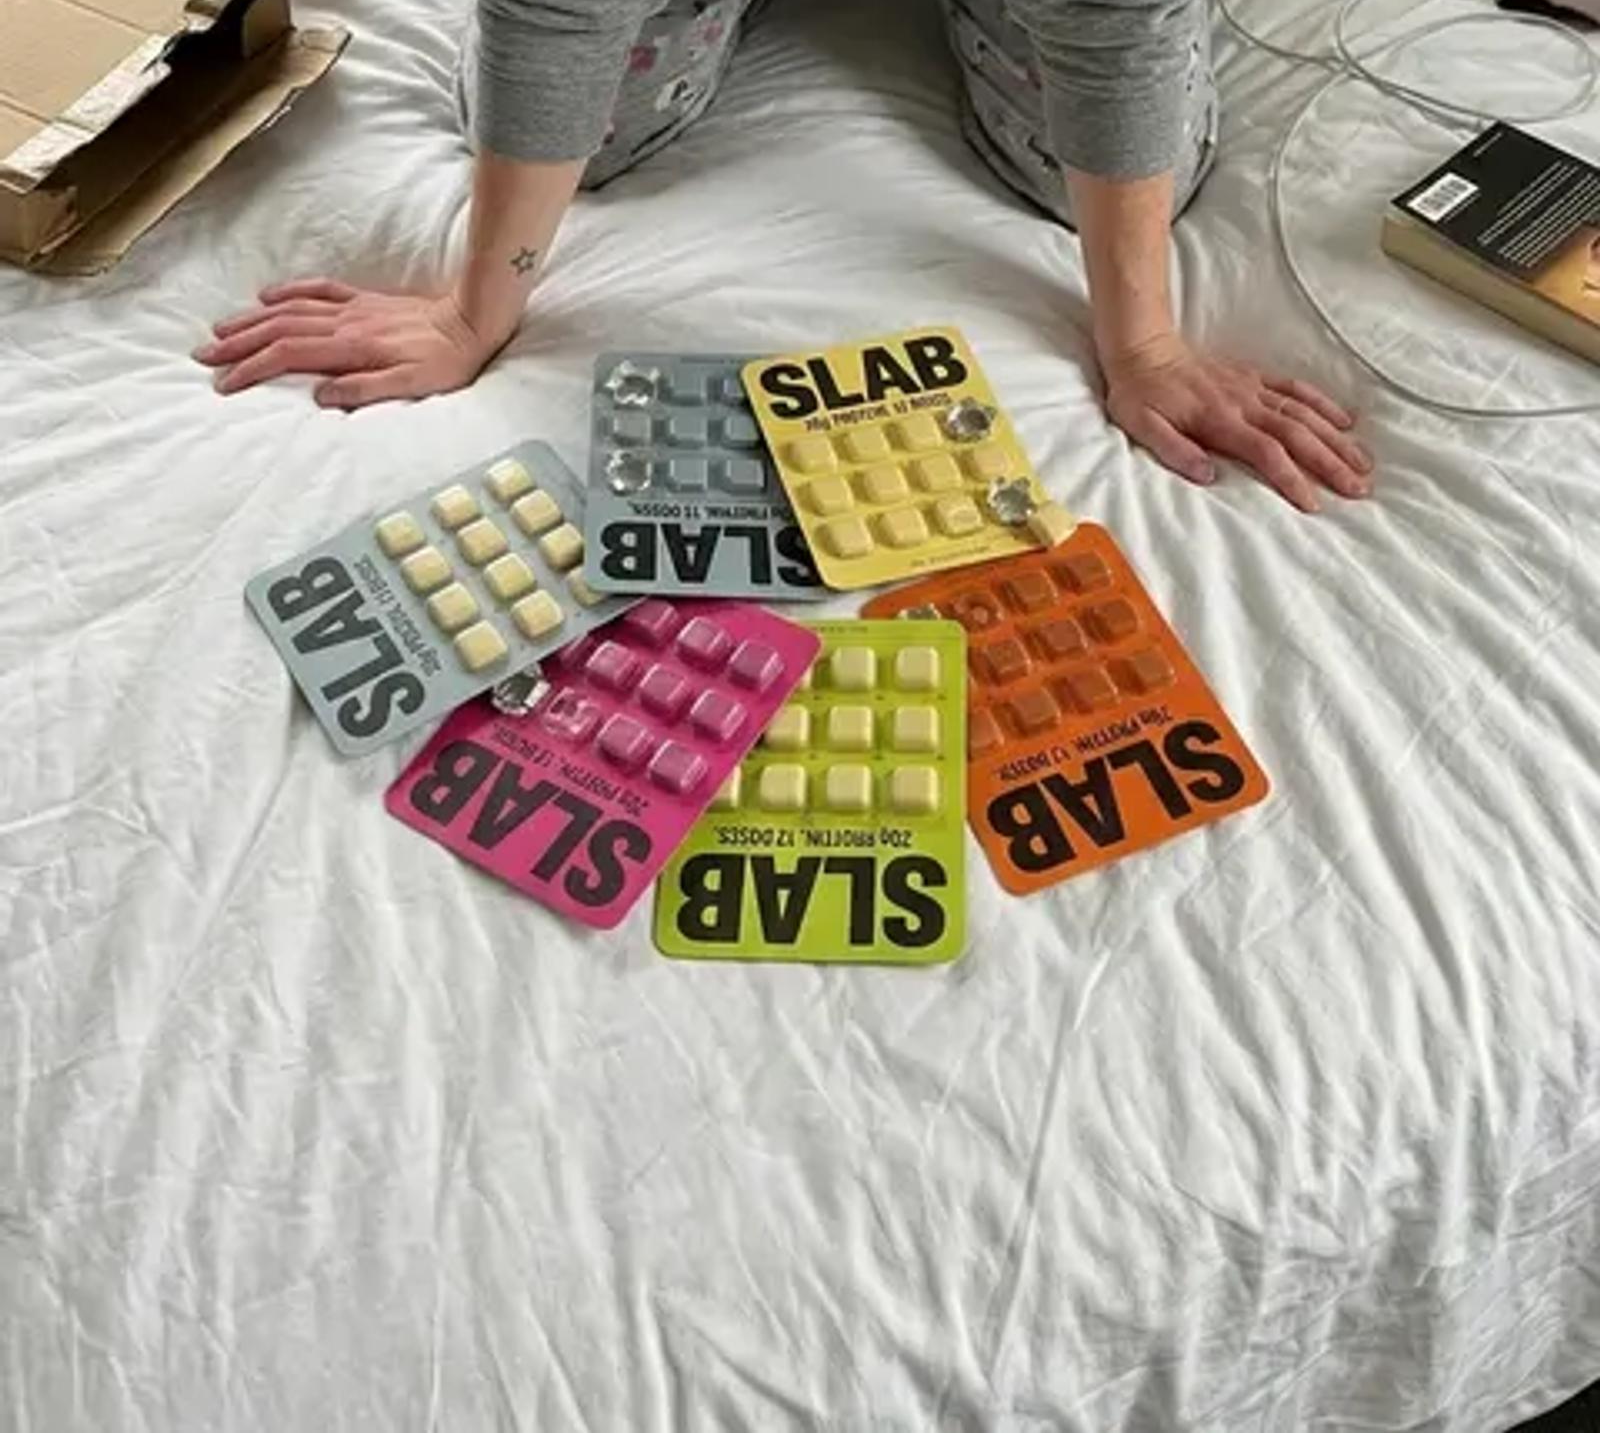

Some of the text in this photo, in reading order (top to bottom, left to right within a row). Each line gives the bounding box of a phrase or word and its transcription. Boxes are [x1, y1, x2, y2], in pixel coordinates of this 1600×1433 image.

[760, 335, 968, 418] SLAB
[600, 521, 826, 587] SLAB
[268, 556, 425, 738] SLAB
[410, 739, 652, 907] SLAB
[776, 828, 796, 847] 12
[880, 827, 912, 848] 20g
[986, 720, 1245, 872] SLAB
[677, 853, 947, 948] SLAB
